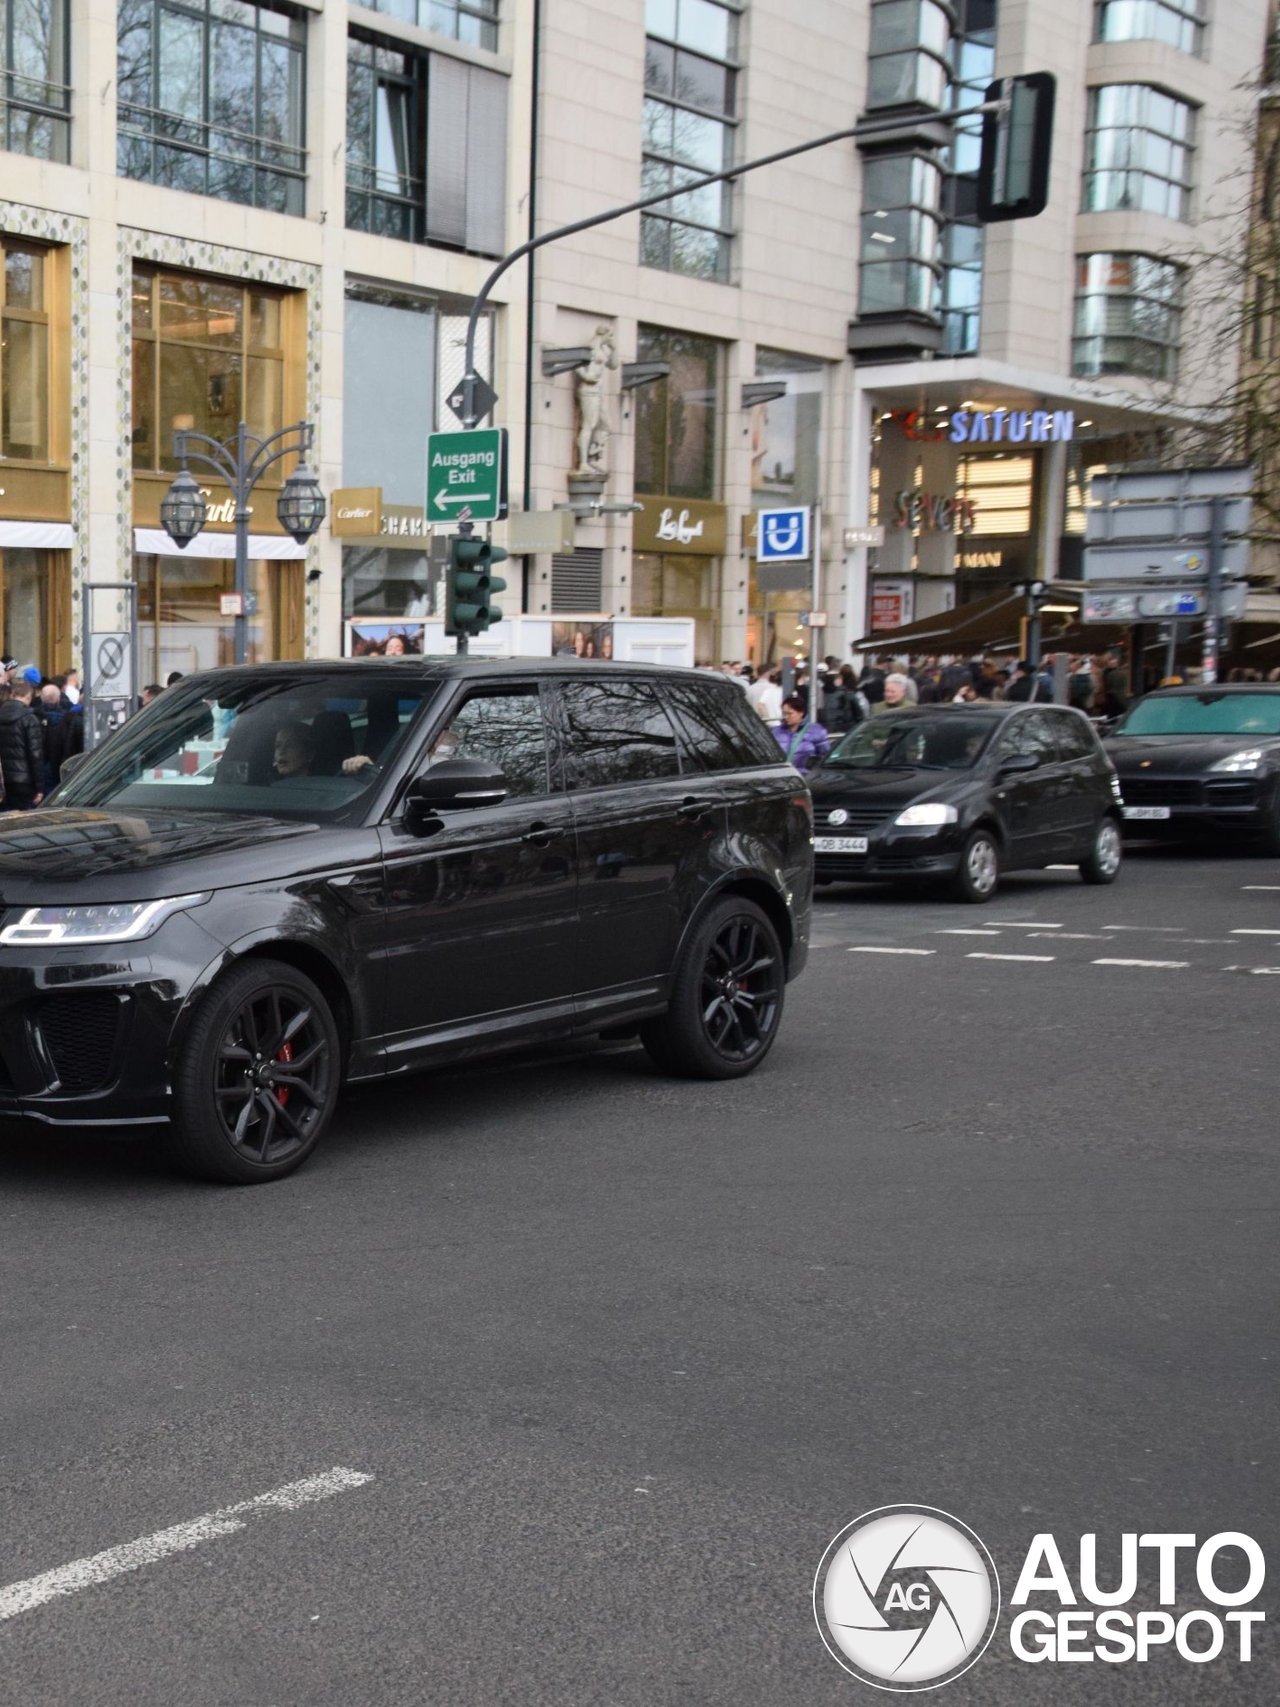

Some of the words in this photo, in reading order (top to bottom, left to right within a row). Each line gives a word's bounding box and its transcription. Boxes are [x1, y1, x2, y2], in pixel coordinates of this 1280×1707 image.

[950, 410, 1074, 444] SATURN
[432, 451, 495, 469] Ausgang
[448, 470, 476, 485] Exit
[336, 507, 373, 520] Cartier
